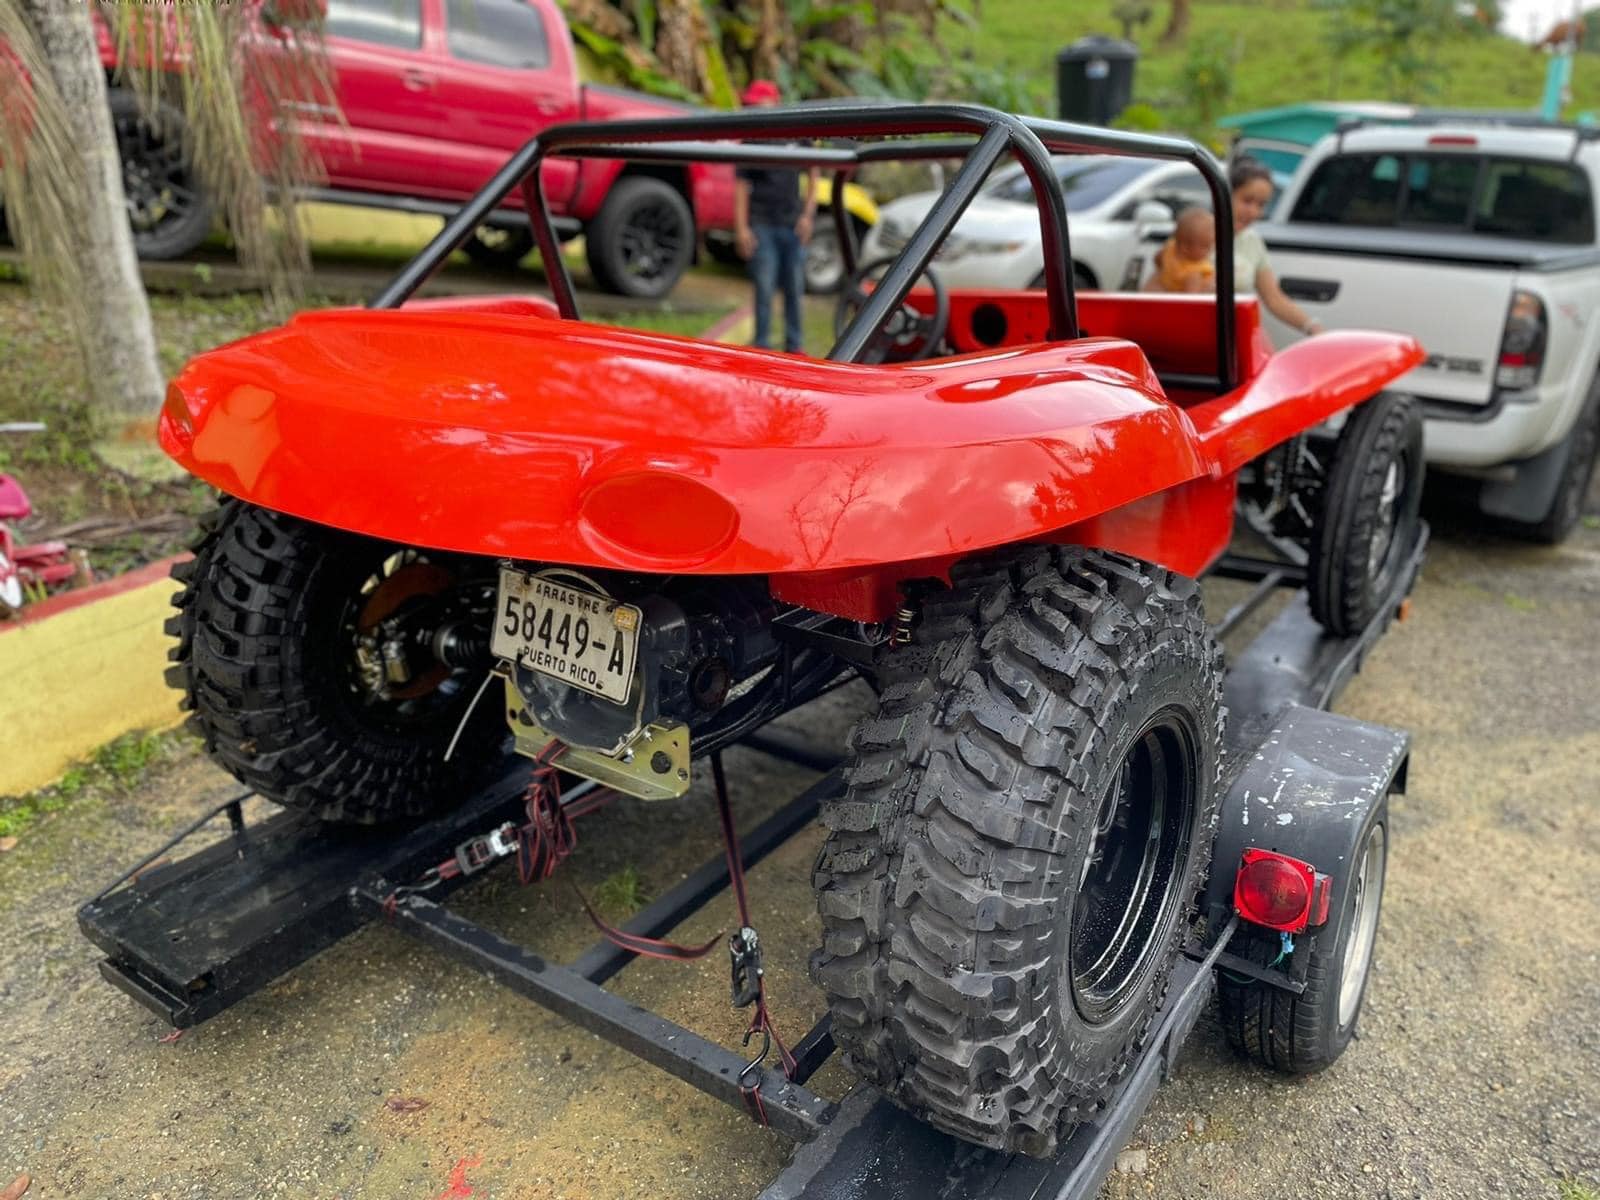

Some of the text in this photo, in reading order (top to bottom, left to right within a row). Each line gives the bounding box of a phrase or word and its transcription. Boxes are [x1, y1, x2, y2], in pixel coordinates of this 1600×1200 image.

[536, 584, 599, 614] ARRASTRE
[504, 597, 624, 675] 58449-A
[524, 646, 597, 685] PUERTO RICO
